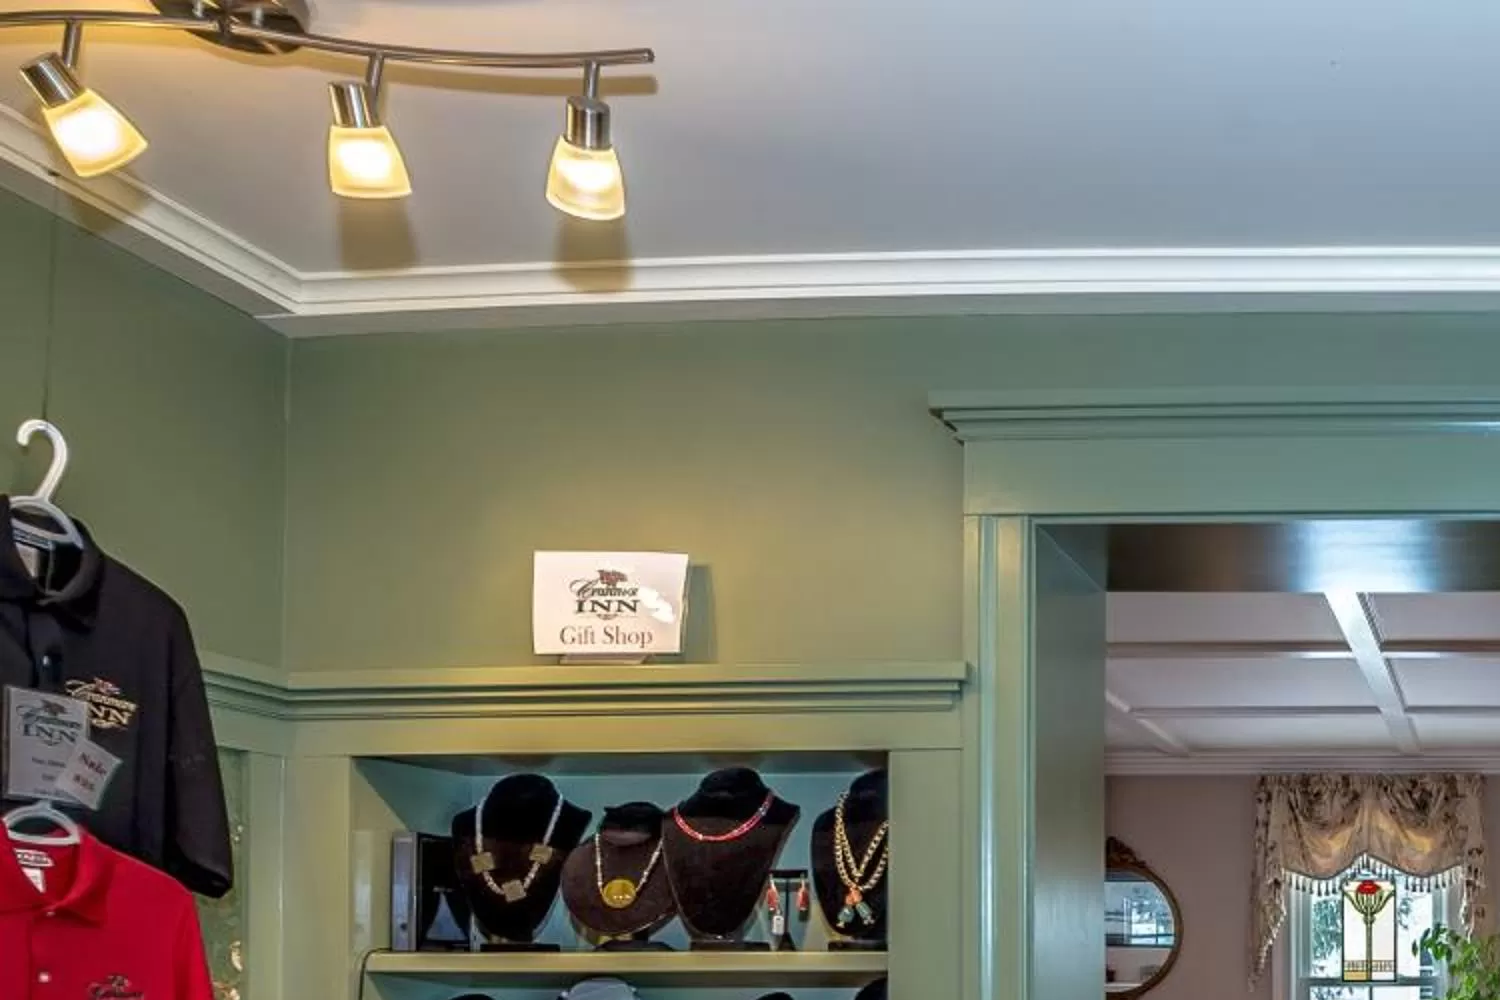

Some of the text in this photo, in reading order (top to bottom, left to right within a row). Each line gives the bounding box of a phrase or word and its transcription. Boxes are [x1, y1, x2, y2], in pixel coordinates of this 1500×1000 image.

[574, 599, 642, 615] INN
[559, 624, 654, 649] Gift Shop
[22, 723, 79, 745] INN
